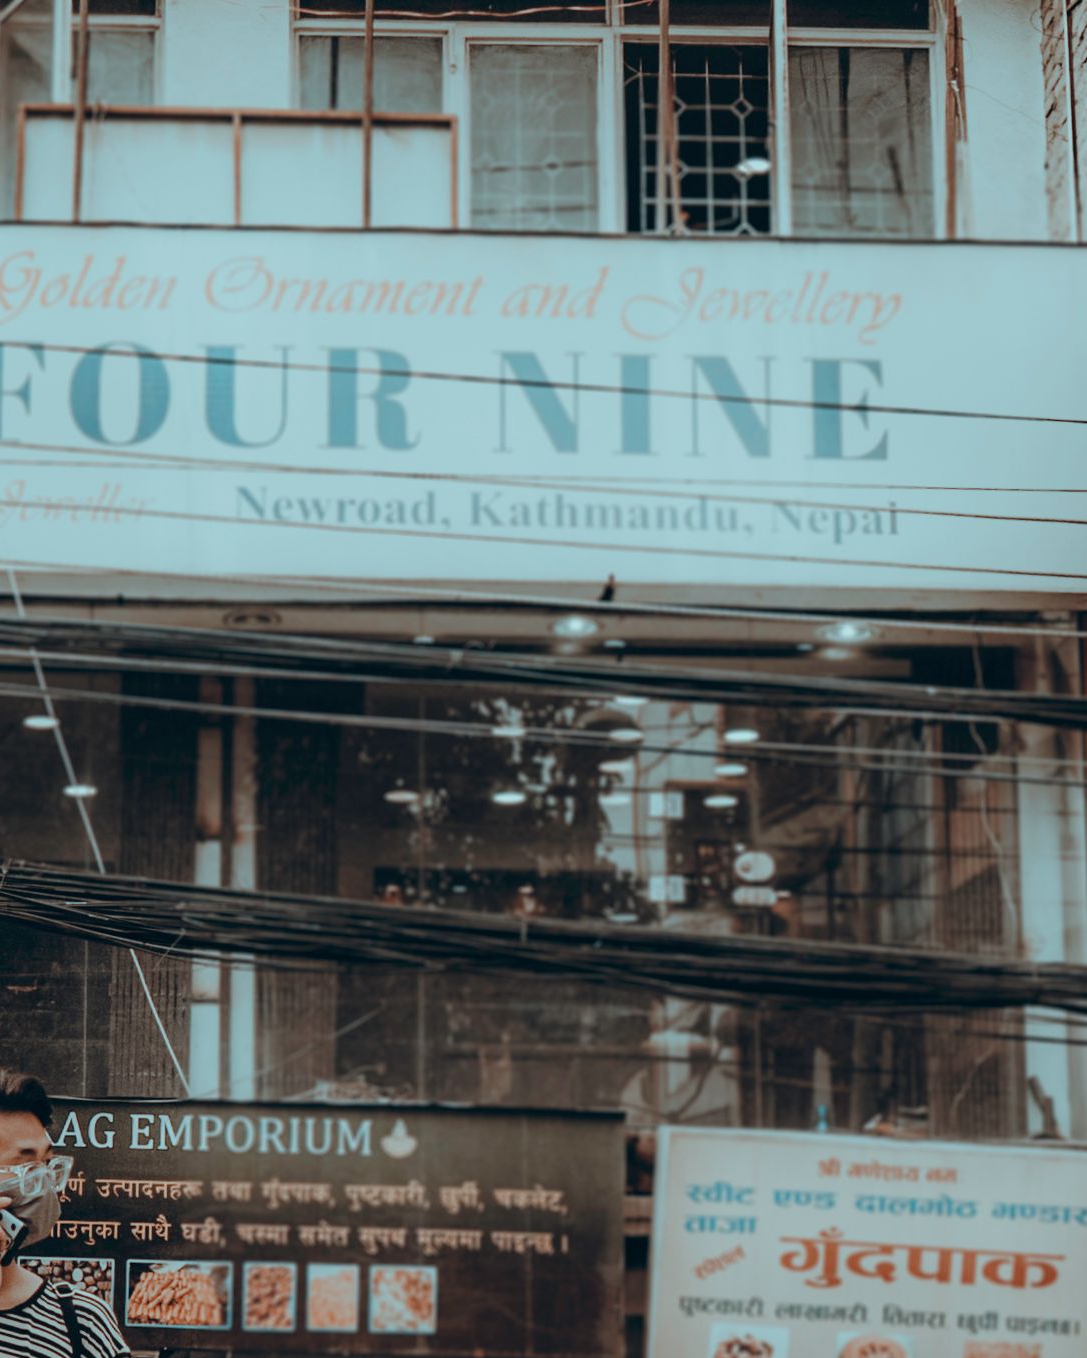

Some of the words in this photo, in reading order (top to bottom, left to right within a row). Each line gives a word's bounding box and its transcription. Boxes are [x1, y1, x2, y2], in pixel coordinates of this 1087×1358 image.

[204, 255, 486, 317] Ornament
[500, 266, 610, 319] and
[620, 267, 903, 345] Jewellery
[493, 350, 889, 461] NINE
[236, 485, 451, 529] Newroad,
[470, 491, 755, 536] Kathmandu,
[772, 501, 899, 545] Nepal
[129, 1112, 373, 1156] EMPORIUM
[130, 1214, 172, 1241] साथै
